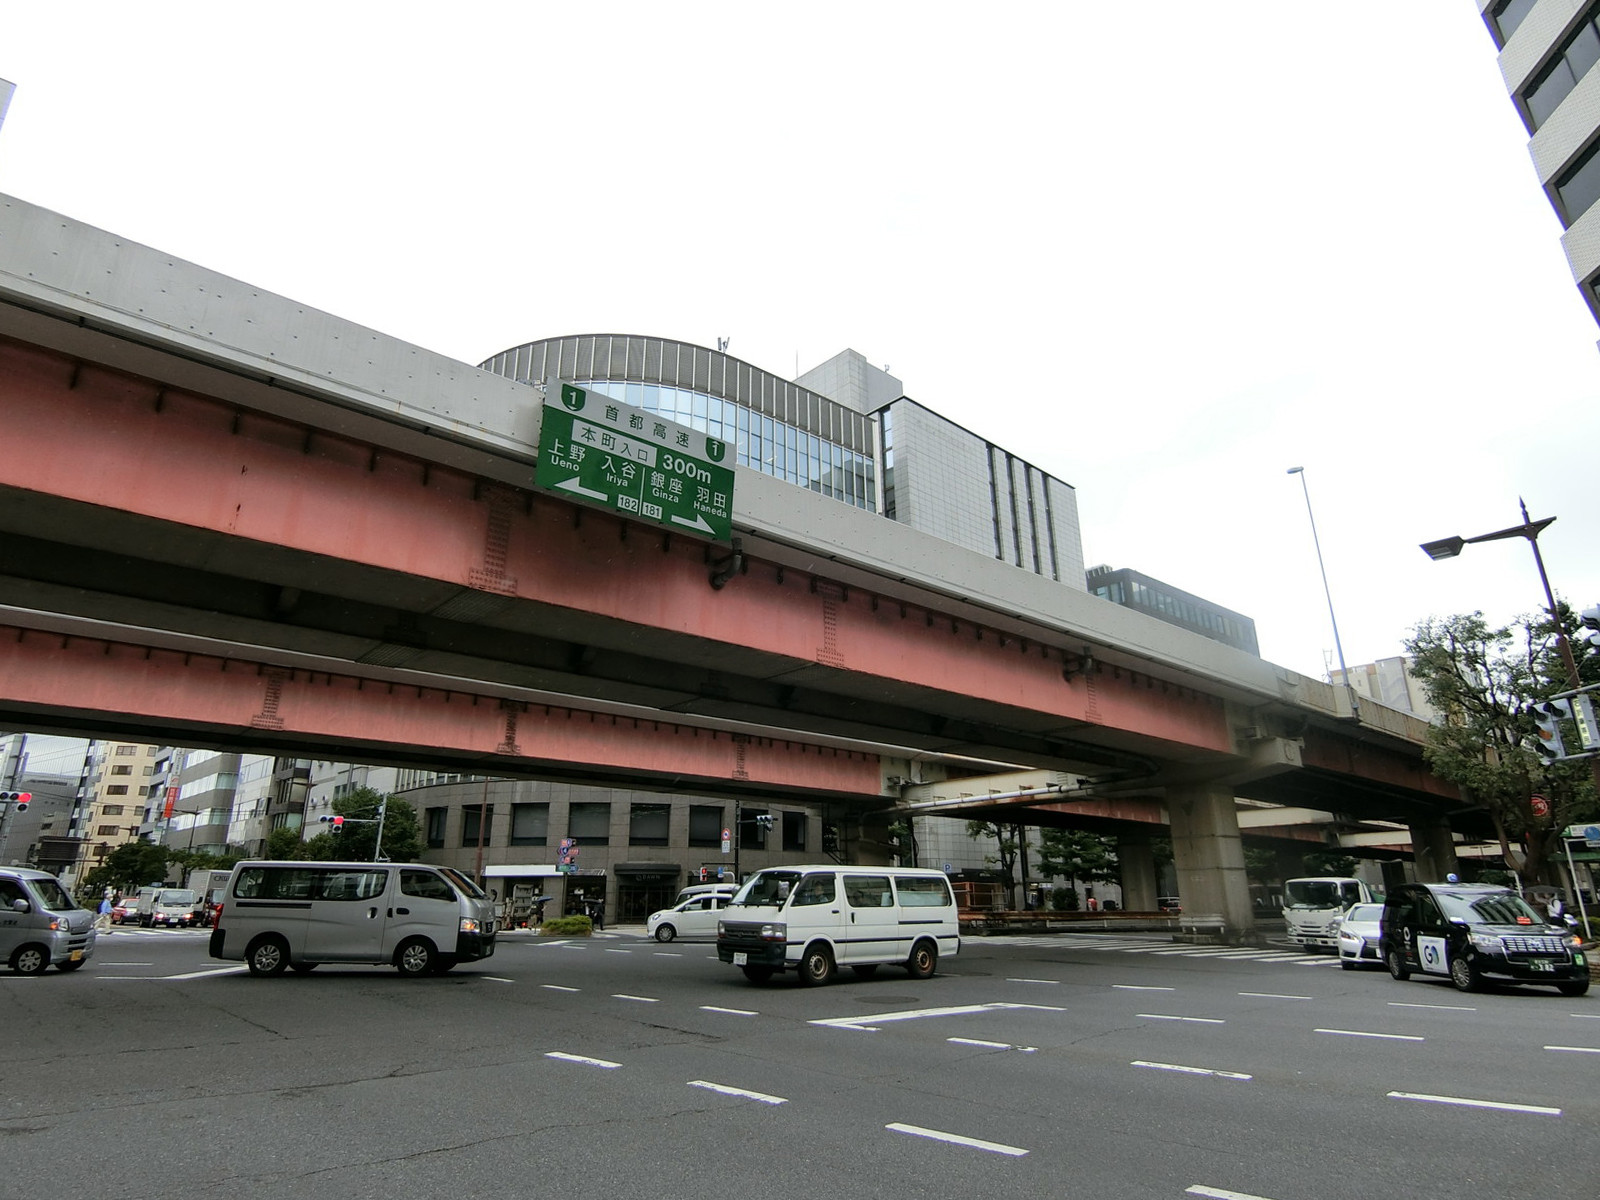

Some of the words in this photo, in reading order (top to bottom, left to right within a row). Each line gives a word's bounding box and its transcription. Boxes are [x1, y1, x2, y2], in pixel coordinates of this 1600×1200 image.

[605, 404, 690, 449] 首都高速
[548, 438, 586, 463] 上野
[601, 455, 637, 480] 入谷
[581, 426, 648, 462] 本町入口
[551, 456, 580, 472] Ueno
[606, 472, 629, 488] Iriya
[662, 454, 712, 484] 300m
[619, 496, 638, 511] 182
[651, 471, 683, 495] 銀座
[697, 486, 727, 508] 羽田
[652, 488, 680, 503] Ginza
[693, 501, 728, 519] Haneda
[644, 504, 661, 518] 181
